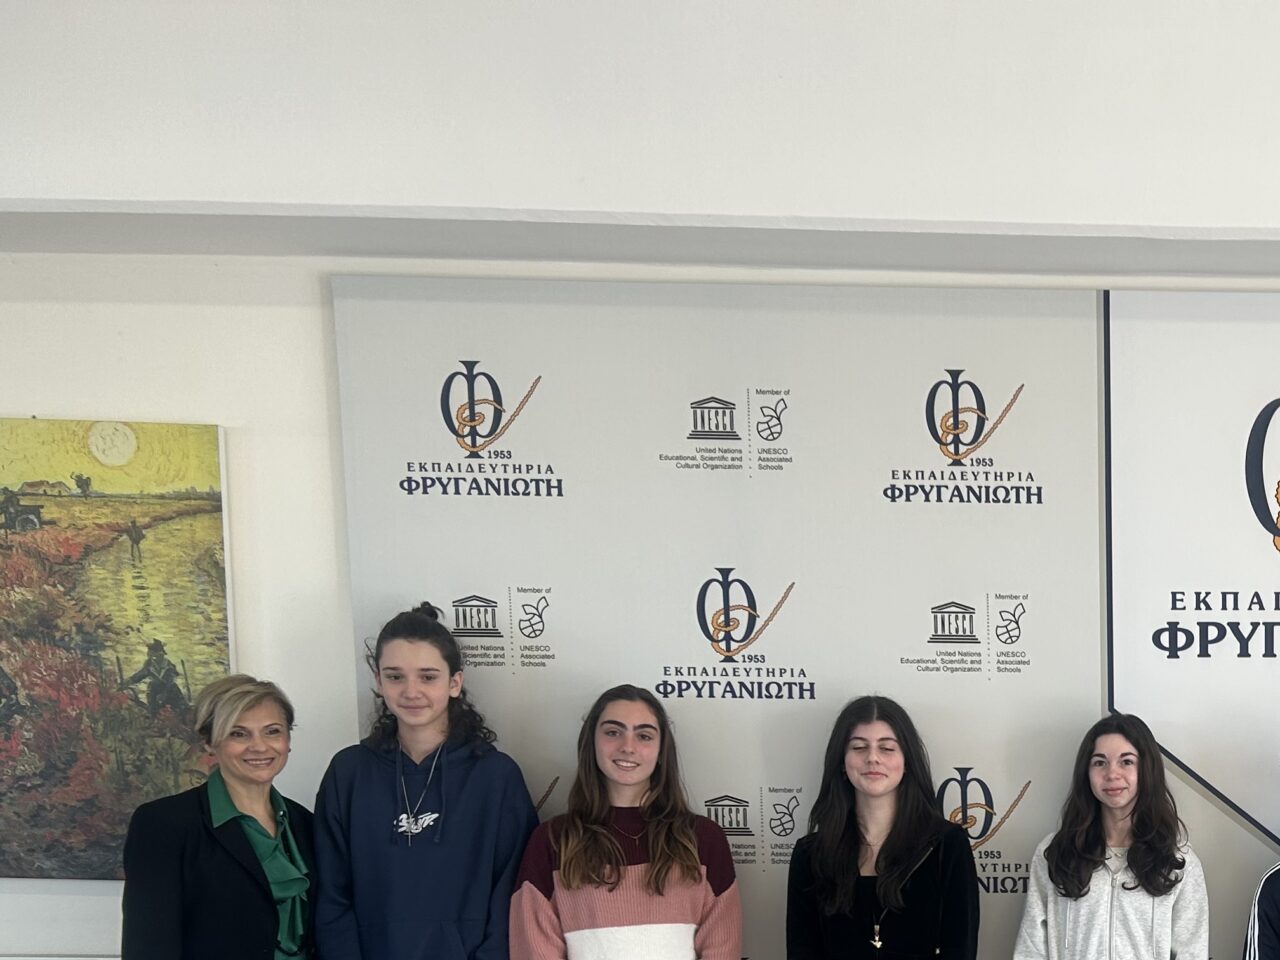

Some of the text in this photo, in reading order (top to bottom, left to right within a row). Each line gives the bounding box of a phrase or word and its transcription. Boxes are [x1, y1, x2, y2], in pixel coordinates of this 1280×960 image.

[692, 410, 734, 431] UNESCO
[487, 450, 512, 460] 1953
[406, 462, 554, 475] ΕΚΠΑΙΔΕΥΤΗΡΙΑ
[702, 463, 743, 471] Organization
[970, 458, 994, 468] 1953
[891, 470, 1034, 482] ΕΚΠΑΙΔΕΥΤΗΡΙΑ
[399, 476, 564, 497] ΦΡΥΓΑΝΙΩΤΗ
[883, 484, 1043, 504] ΦΡΥΓΑΝΙΩΤΗ
[454, 608, 496, 629] UNESCO
[934, 614, 974, 634] UNESCO
[741, 655, 766, 664] 1953
[663, 666, 807, 678] ΕΚΠΑΙΔΕΥΤΗΡΙΑ
[942, 666, 982, 674] Organization
[655, 680, 816, 700] ΦΡΥΓΑΝΙΩΤΗ
[979, 850, 1001, 859] 1953
